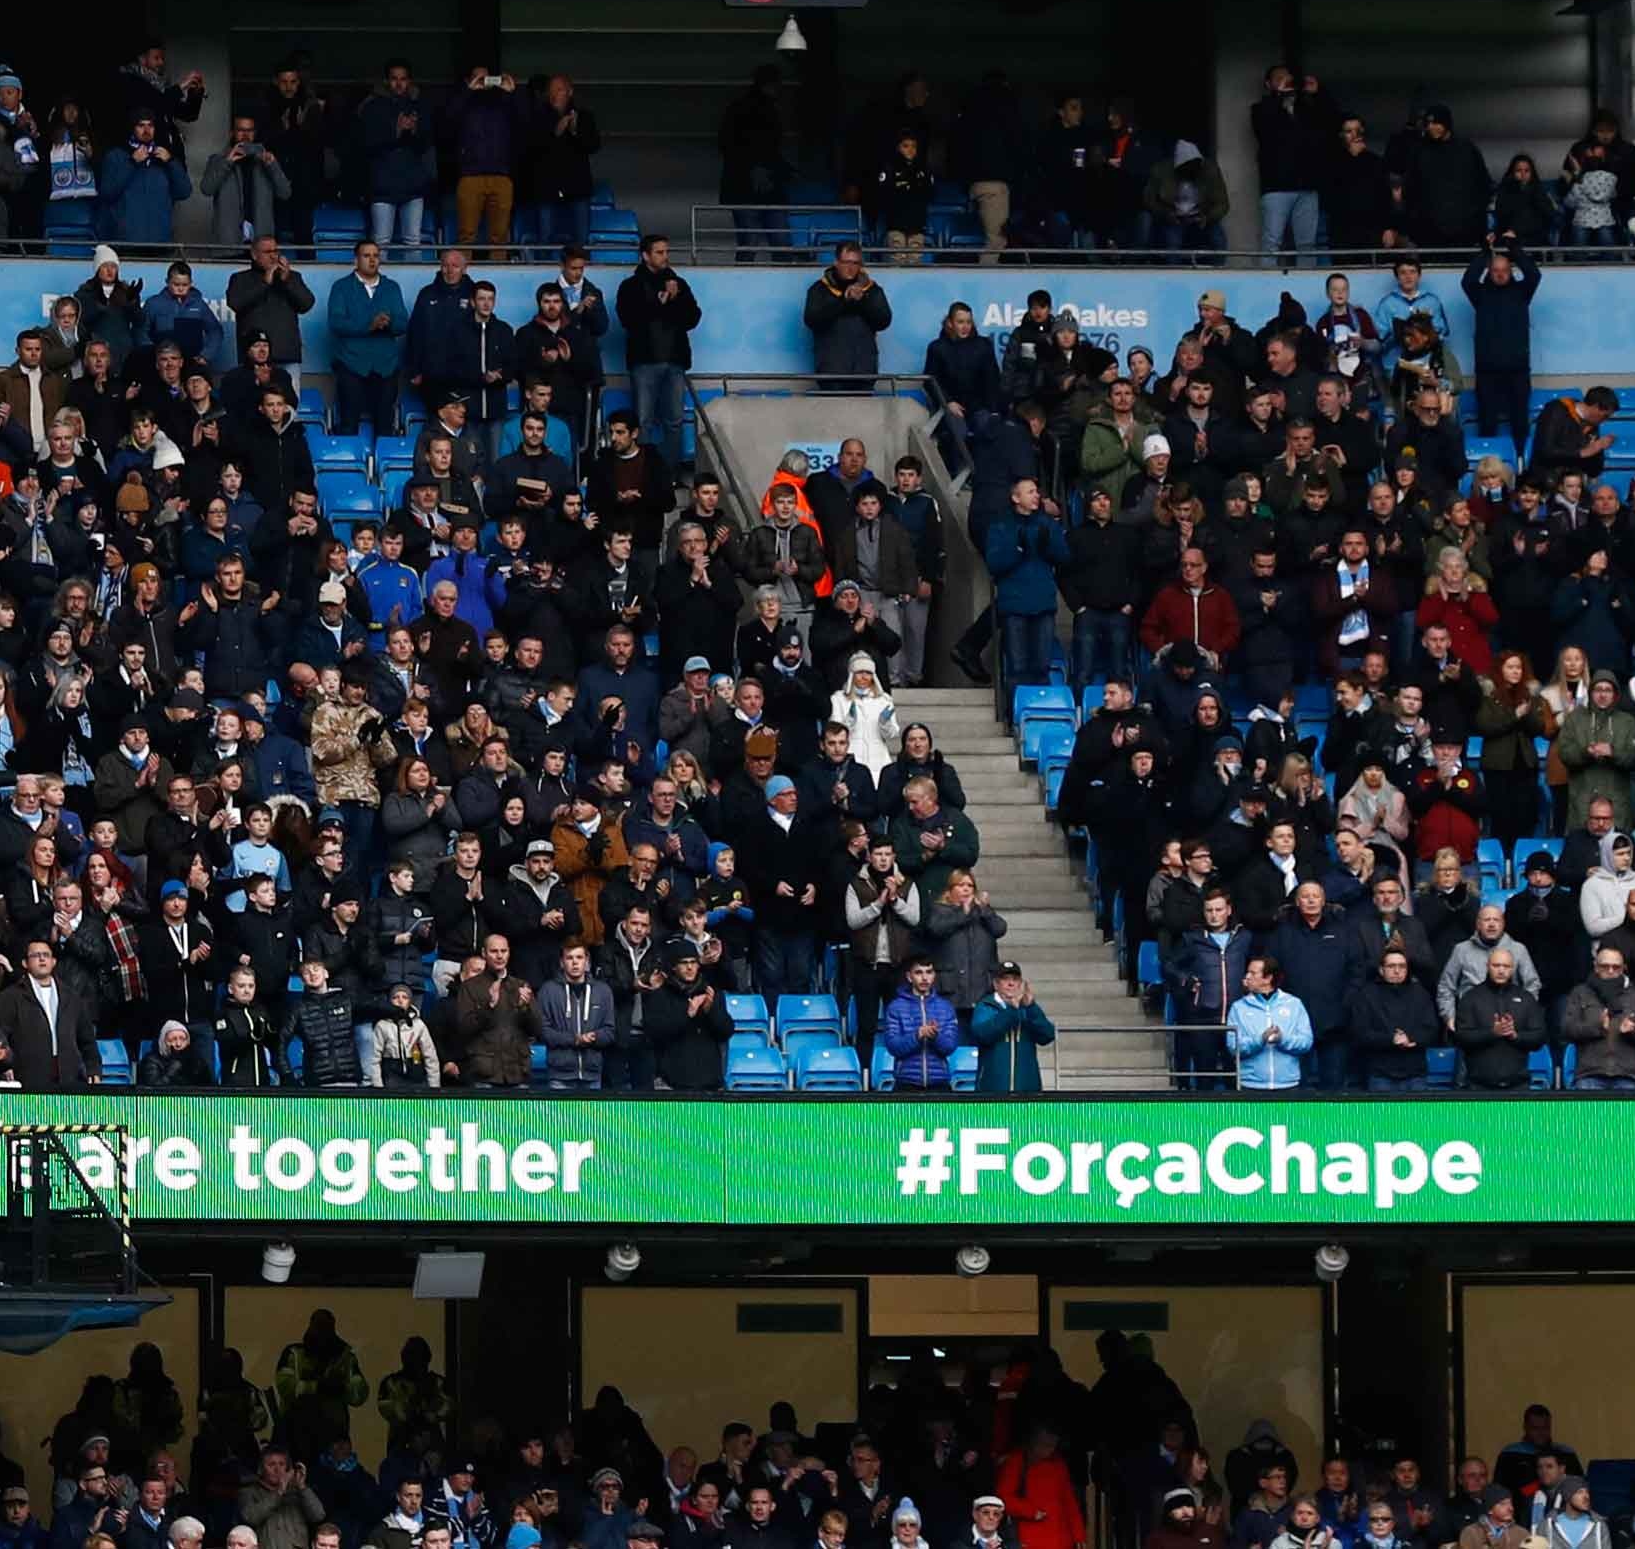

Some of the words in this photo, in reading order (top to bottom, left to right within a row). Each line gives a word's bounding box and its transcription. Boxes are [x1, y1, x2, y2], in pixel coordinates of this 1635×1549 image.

[810, 454, 834, 470] 33
[75, 1135, 203, 1191] are
[229, 1121, 595, 1206] together
[896, 1124, 1483, 1209] #ForçaChape
